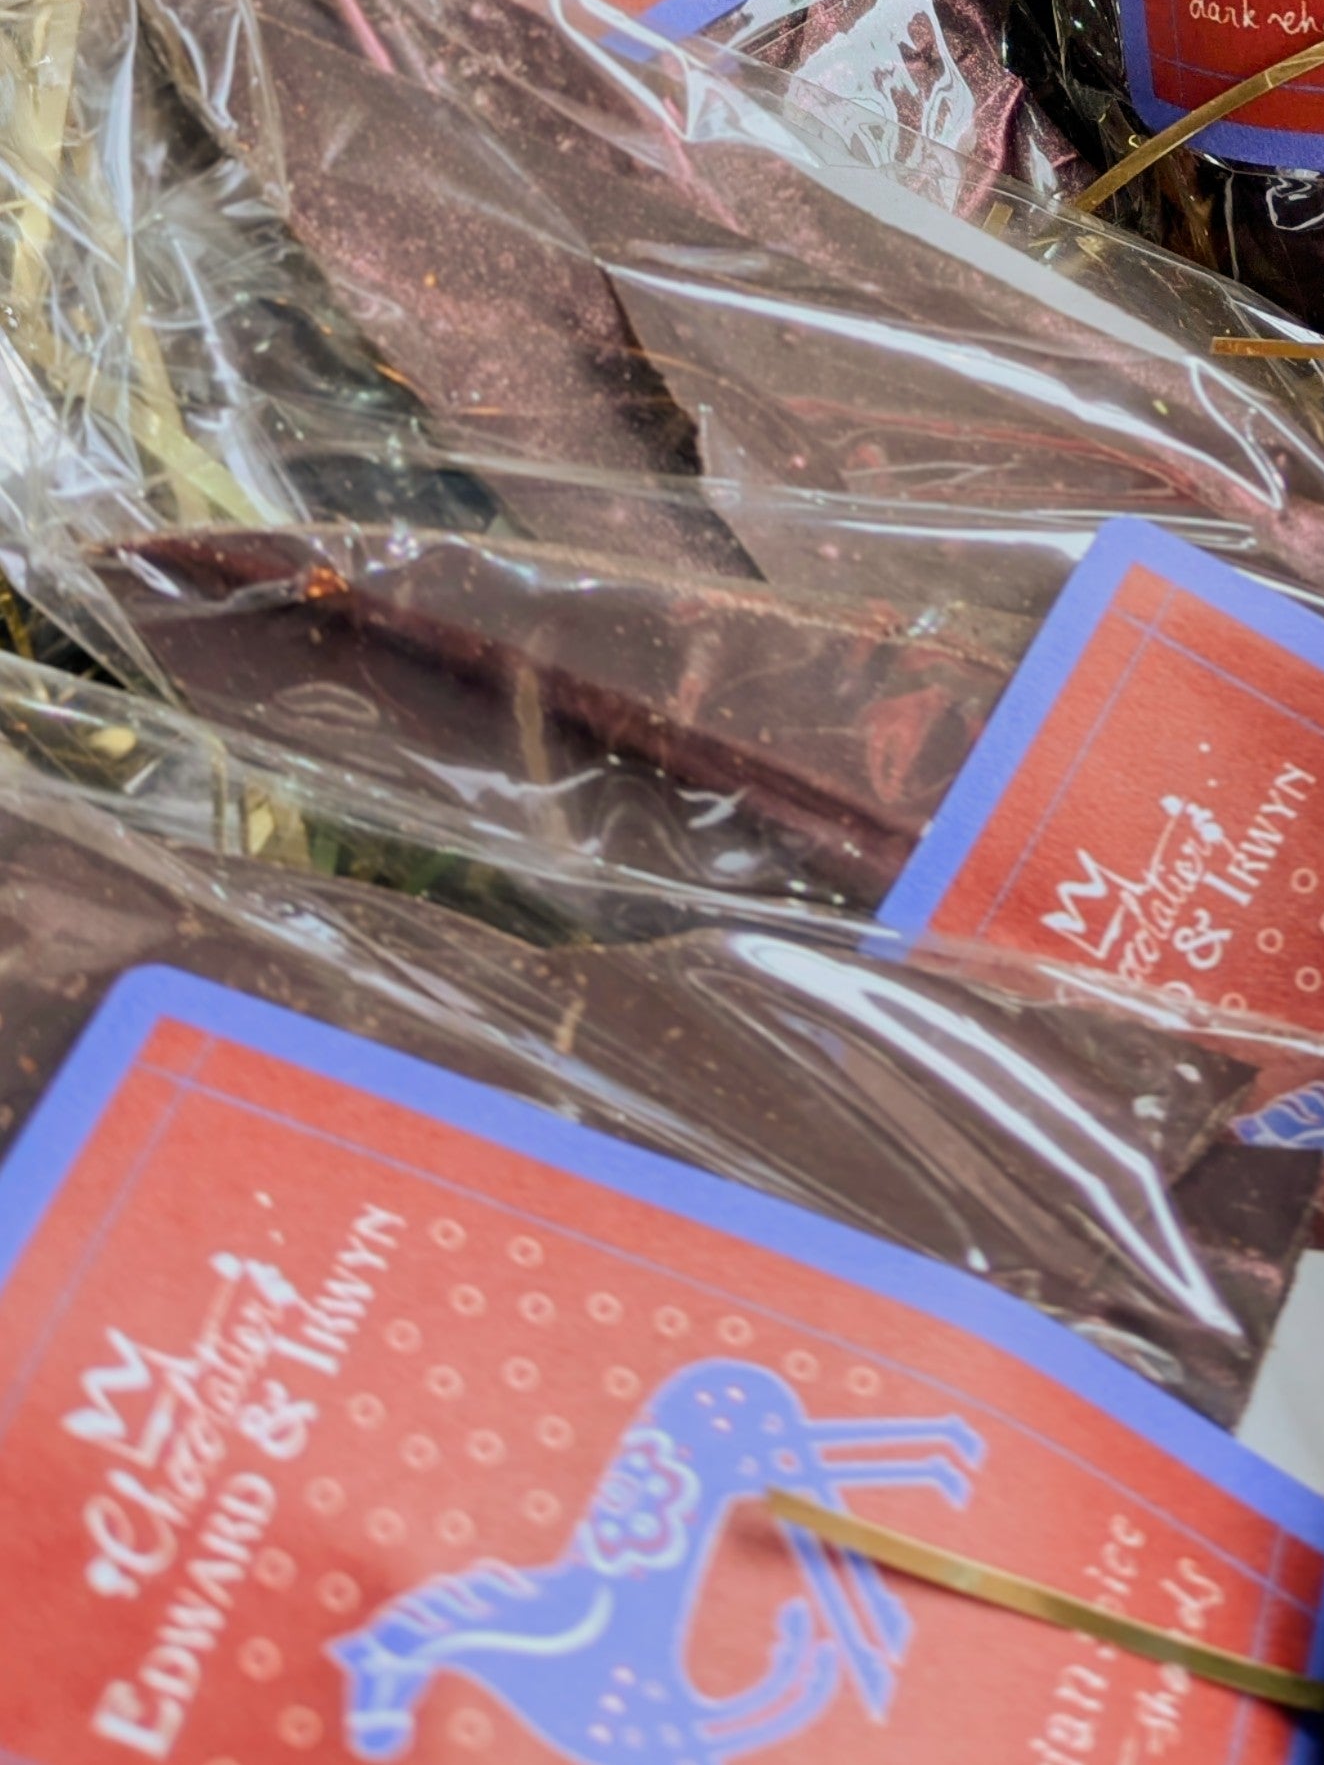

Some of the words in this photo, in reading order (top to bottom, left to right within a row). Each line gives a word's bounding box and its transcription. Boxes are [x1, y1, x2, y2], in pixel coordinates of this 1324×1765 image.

[1173, 909, 1233, 970] &
[1204, 761, 1317, 906] IRWYN
[271, 1201, 407, 1376] IRWYN
[239, 1378, 320, 1460] &
[92, 1471, 276, 1759] EDWARD
